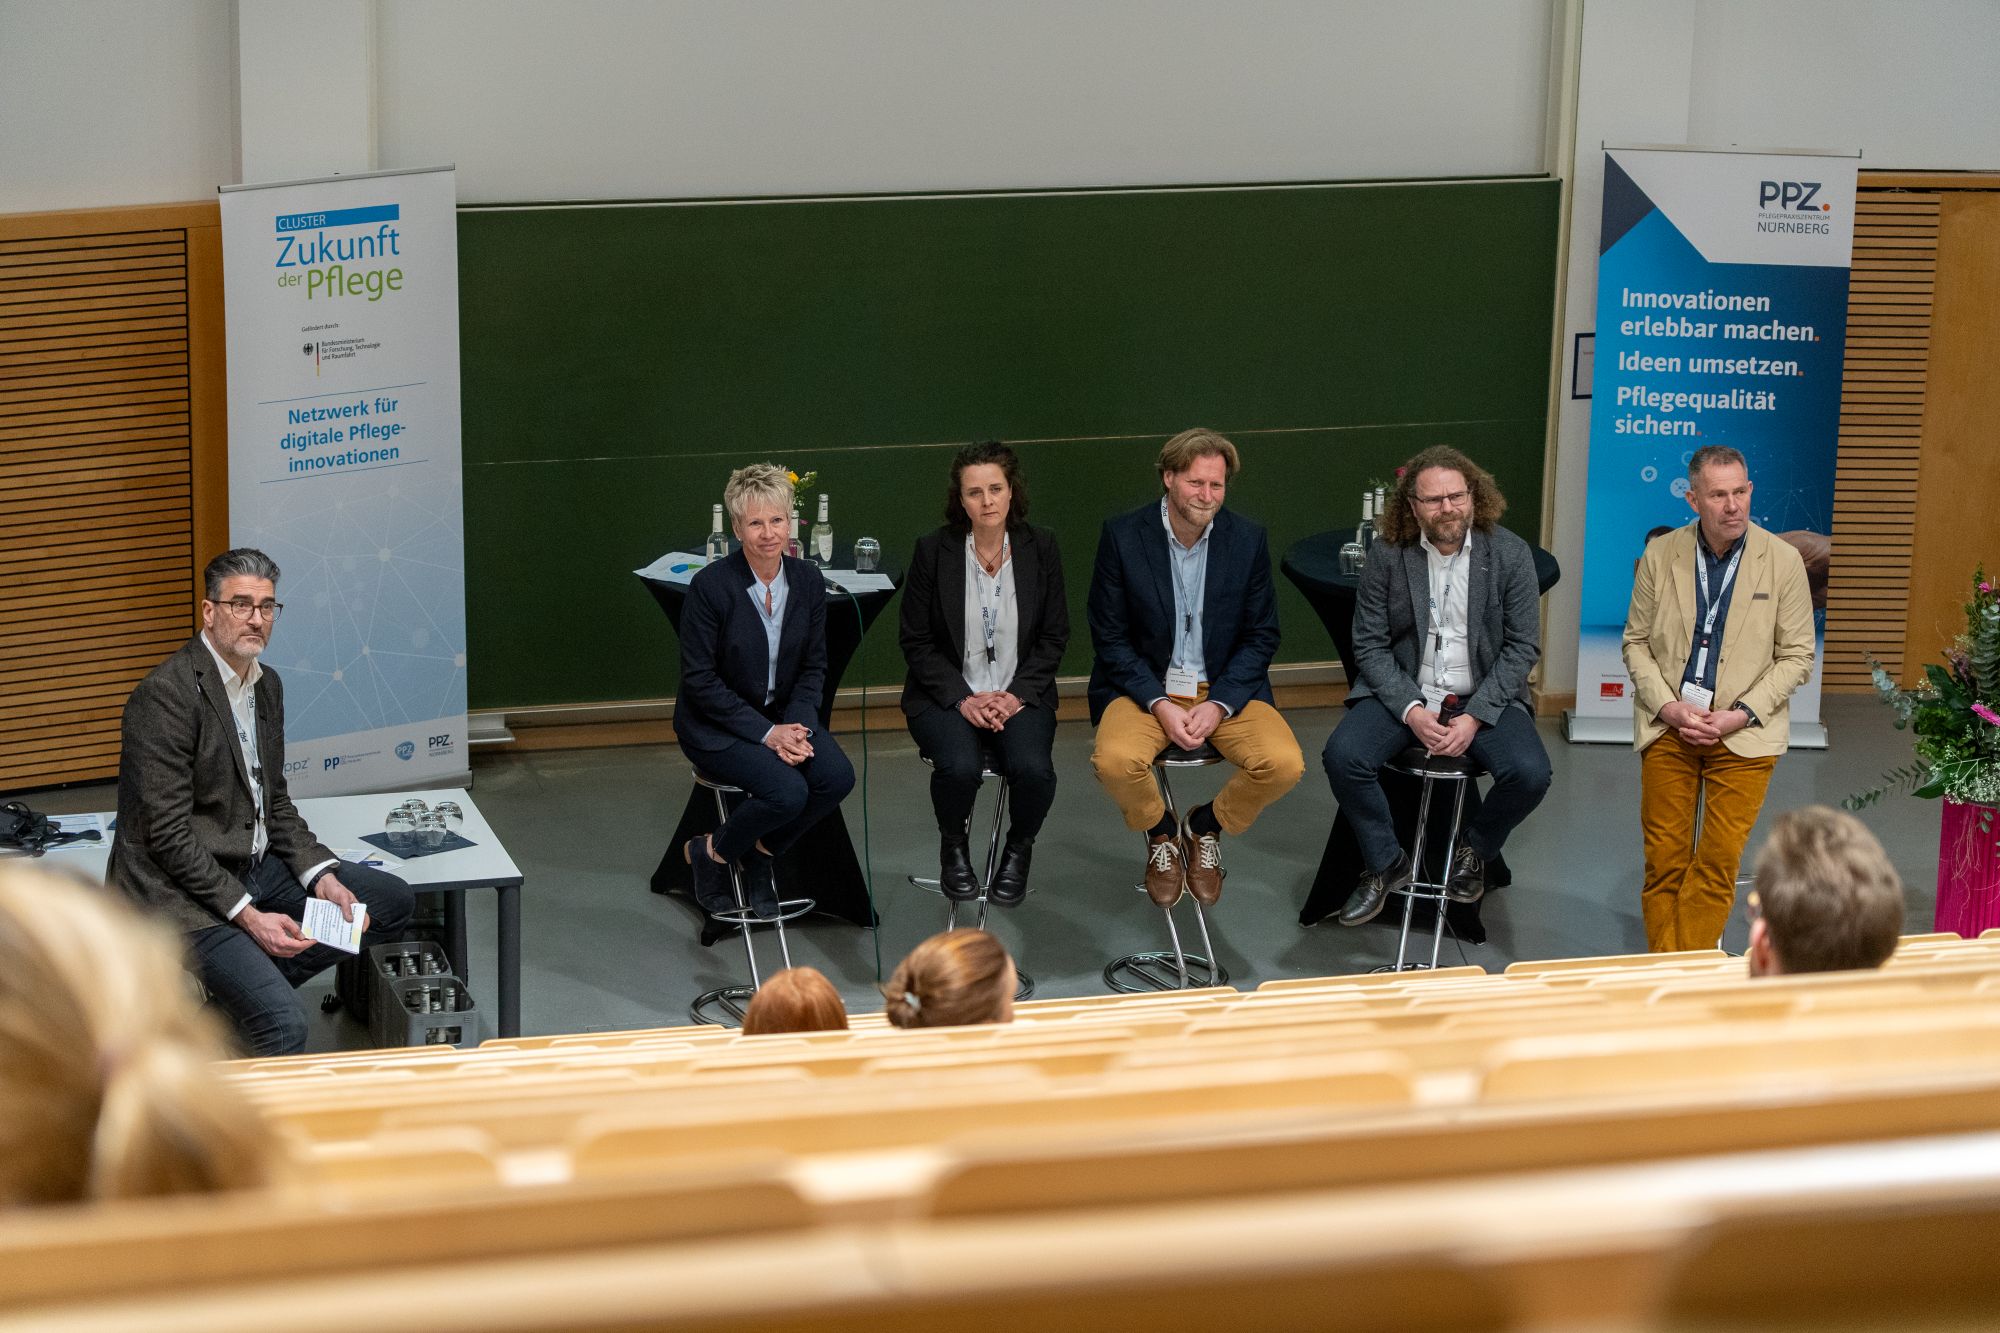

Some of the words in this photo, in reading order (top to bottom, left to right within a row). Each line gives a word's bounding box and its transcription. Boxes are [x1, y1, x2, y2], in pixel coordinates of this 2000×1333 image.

[278, 214, 326, 230] CLUSTER
[1757, 221, 1830, 235] NÜRNBERG
[1758, 212, 1830, 221] PFLEGEPRAXISZENTRUM
[276, 224, 400, 267] Zukunft
[277, 271, 303, 288] der
[307, 264, 403, 302] Pflege
[1622, 287, 1770, 312] Innovationen
[1620, 315, 1718, 338] erlebbar
[1723, 319, 1820, 342] machen.
[331, 351, 357, 360] Raumfahrt
[1619, 350, 1681, 373] Ideen
[1688, 356, 1804, 376] umsetzen.
[288, 399, 370, 425] Netzwerk
[374, 397, 399, 414] für
[1617, 385, 1776, 413] Pflegequalität
[280, 426, 344, 452] digitale
[349, 422, 407, 441] Pflege-
[1614, 412, 1702, 437] sichern.
[288, 445, 400, 473] innovationen
